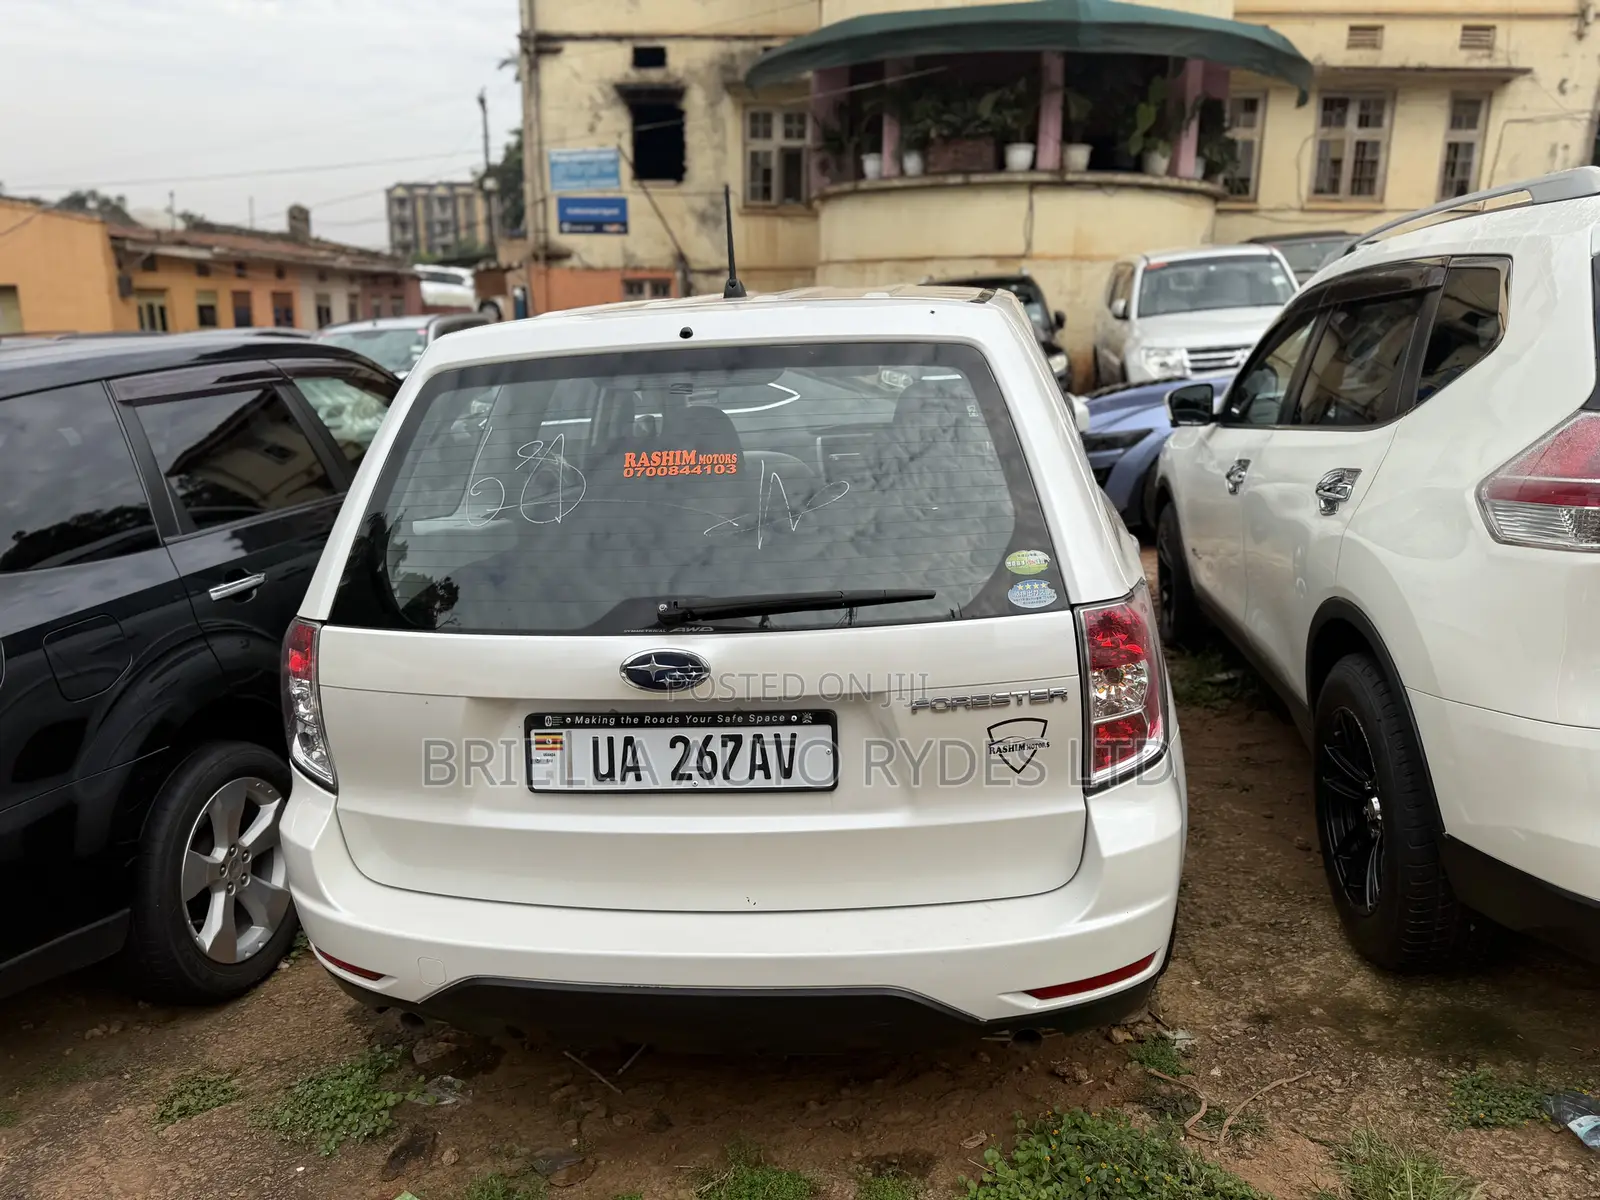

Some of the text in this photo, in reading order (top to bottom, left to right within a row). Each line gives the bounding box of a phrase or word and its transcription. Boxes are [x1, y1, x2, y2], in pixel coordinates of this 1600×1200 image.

[624, 450, 738, 468] RASHIM MOTORS
[623, 464, 738, 478] 0700844103
[910, 686, 1068, 715] FORESTER
[574, 715, 616, 726] Making
[620, 715, 639, 724] the
[644, 714, 680, 724] Roads
[685, 714, 712, 724] Your
[717, 714, 744, 723] Safe
[748, 713, 785, 724] Space
[989, 743, 1026, 755] RASHIM
[592, 732, 798, 783] UA 267AV
